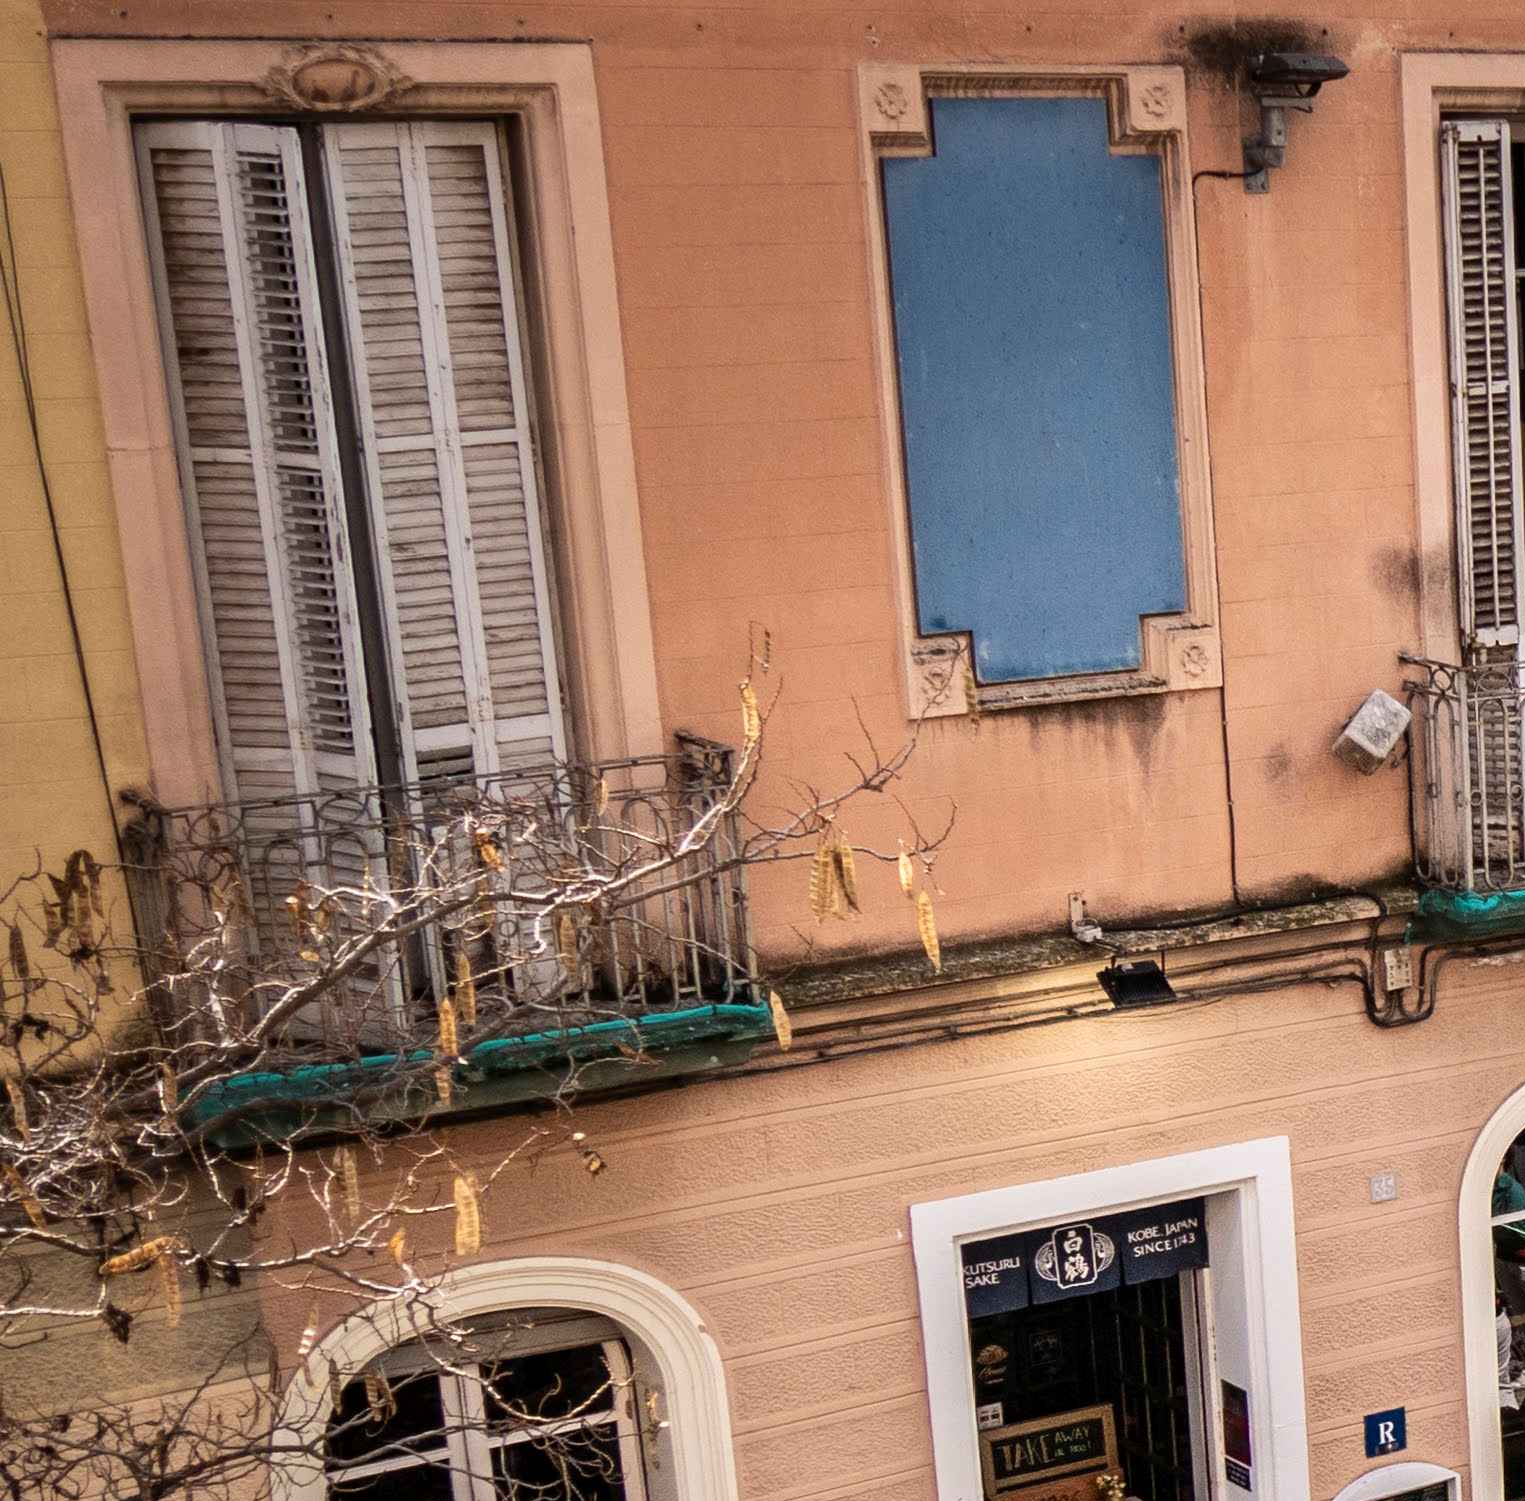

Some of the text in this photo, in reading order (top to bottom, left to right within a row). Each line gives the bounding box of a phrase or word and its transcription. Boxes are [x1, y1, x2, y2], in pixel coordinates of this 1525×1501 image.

[1372, 1177, 1394, 1198] 35
[1165, 1218, 1198, 1236] JAPAN
[1133, 1240, 1172, 1257] SINCE
[966, 1272, 1000, 1288] SAKE
[1378, 1421, 1396, 1445] R
[1000, 1434, 1056, 1472] TAKE
[1055, 1426, 1091, 1445] AWAY
